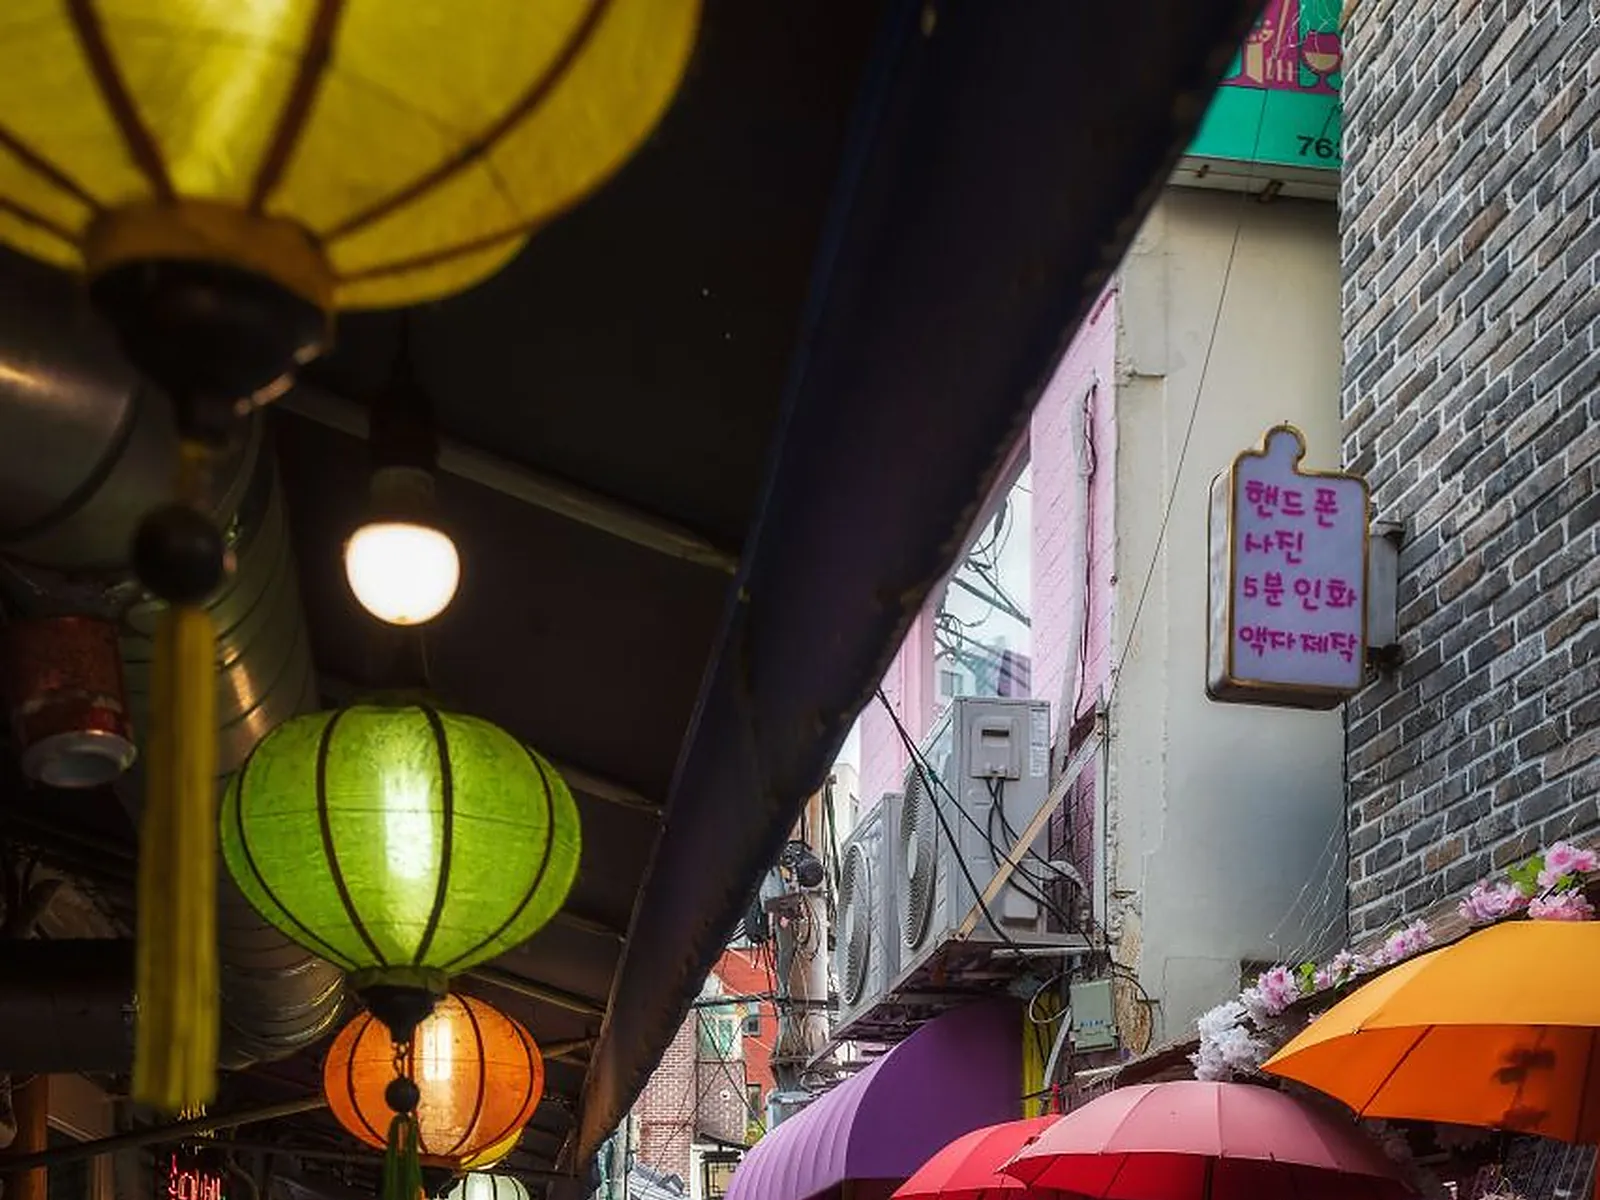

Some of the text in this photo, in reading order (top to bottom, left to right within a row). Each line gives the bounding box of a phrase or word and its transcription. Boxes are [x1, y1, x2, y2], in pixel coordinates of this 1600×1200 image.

[1245, 480, 1338, 528] 핸드폰
[1245, 530, 1304, 565] 사진
[1243, 572, 1357, 611] 5분 인화
